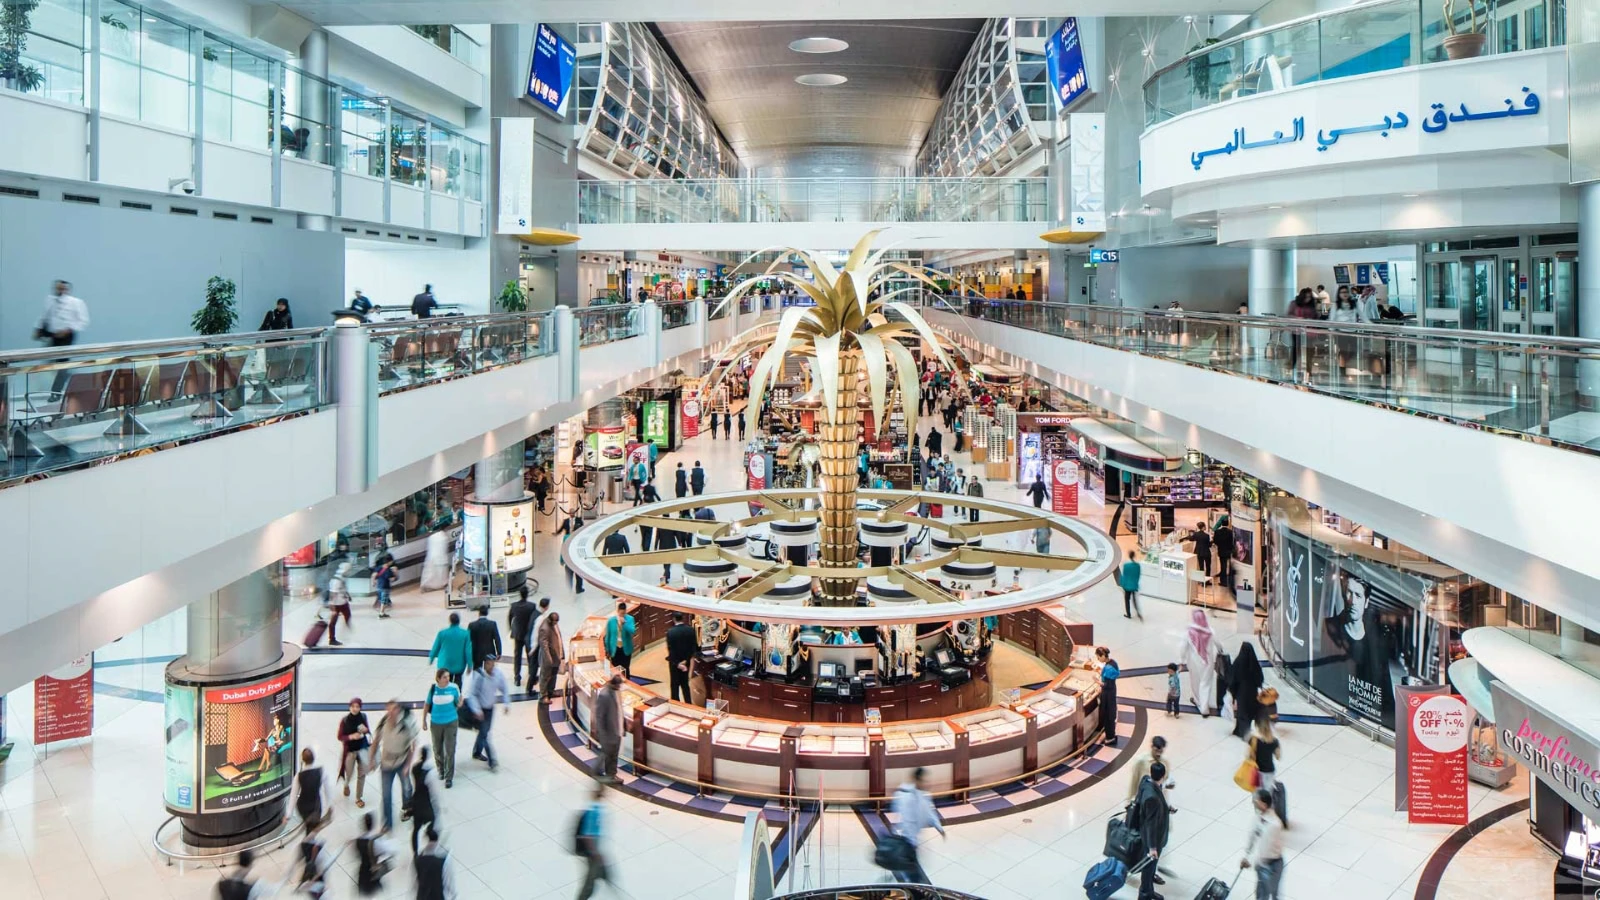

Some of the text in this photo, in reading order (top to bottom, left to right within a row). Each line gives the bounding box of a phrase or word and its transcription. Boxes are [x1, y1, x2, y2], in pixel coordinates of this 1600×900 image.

[1190, 87, 1540, 170] فندق دبي العالمي
[1101, 251, 1117, 261] C15
[222, 681, 282, 701] Dubai Duty Free
[1348, 673, 1383, 697] LA NUIT DE
[1348, 682, 1382, 706] L'HOMME
[1419, 710, 1443, 720] 20%
[1445, 709, 1463, 717] خصم
[1420, 719, 1442, 728] OFF
[1503, 728, 1600, 809] cosmetics
[229, 794, 243, 802] Full
